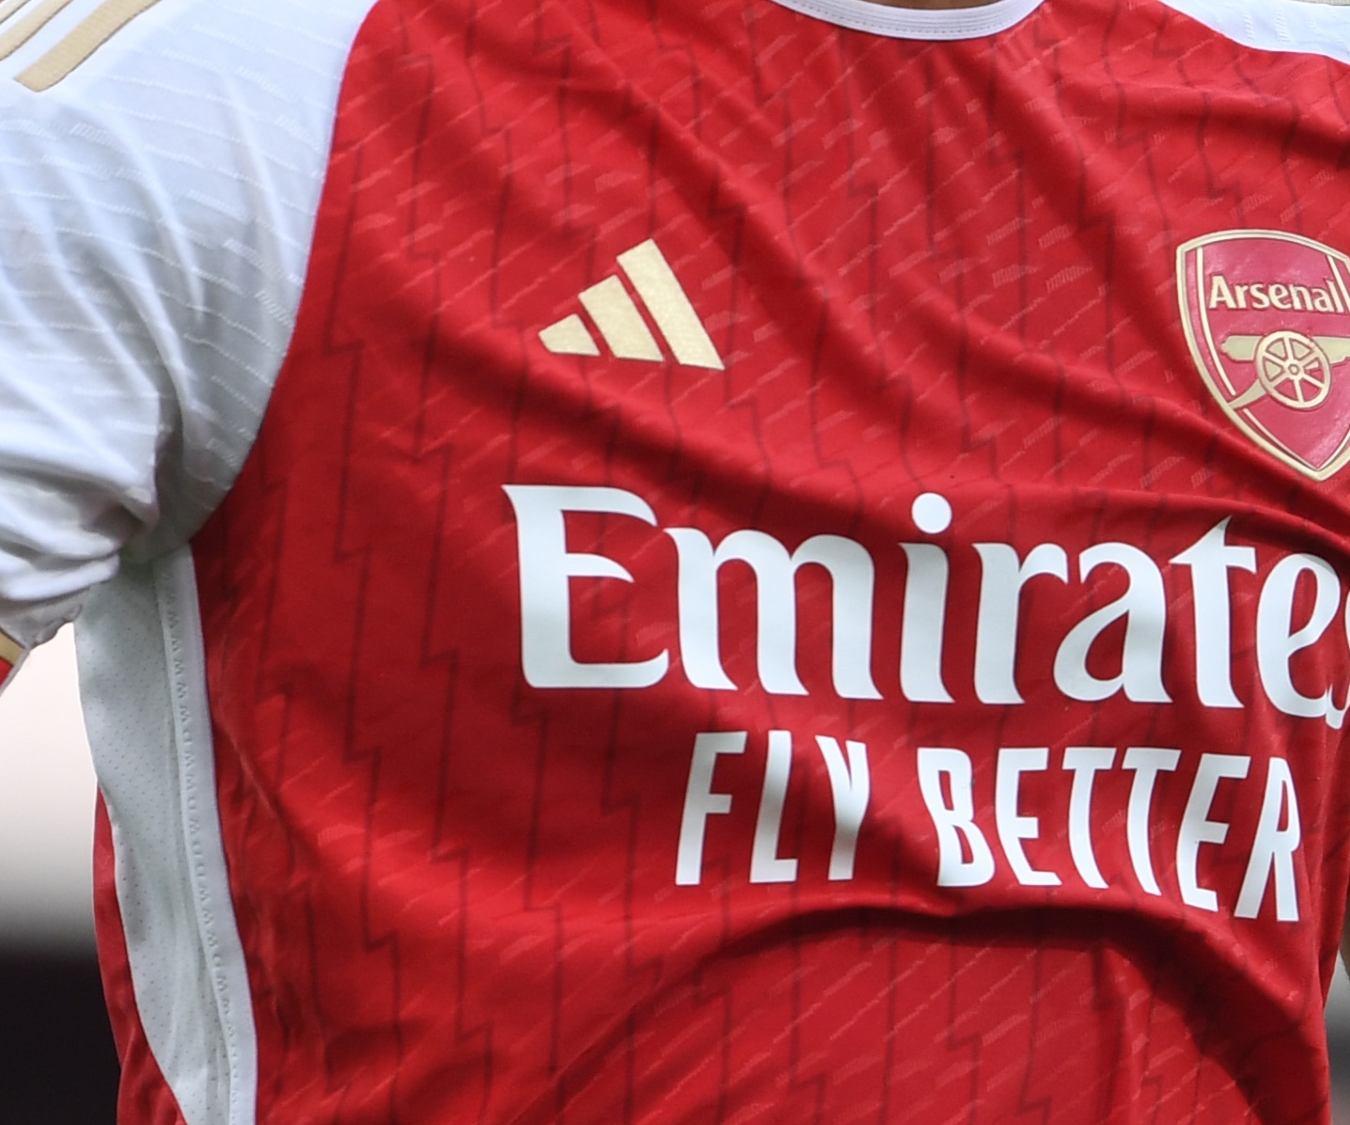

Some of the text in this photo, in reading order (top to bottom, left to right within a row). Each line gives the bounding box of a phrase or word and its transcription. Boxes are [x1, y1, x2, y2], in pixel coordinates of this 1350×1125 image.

[1208, 274, 1345, 314] Arsenal
[675, 729, 1301, 922] FLY BETTER
